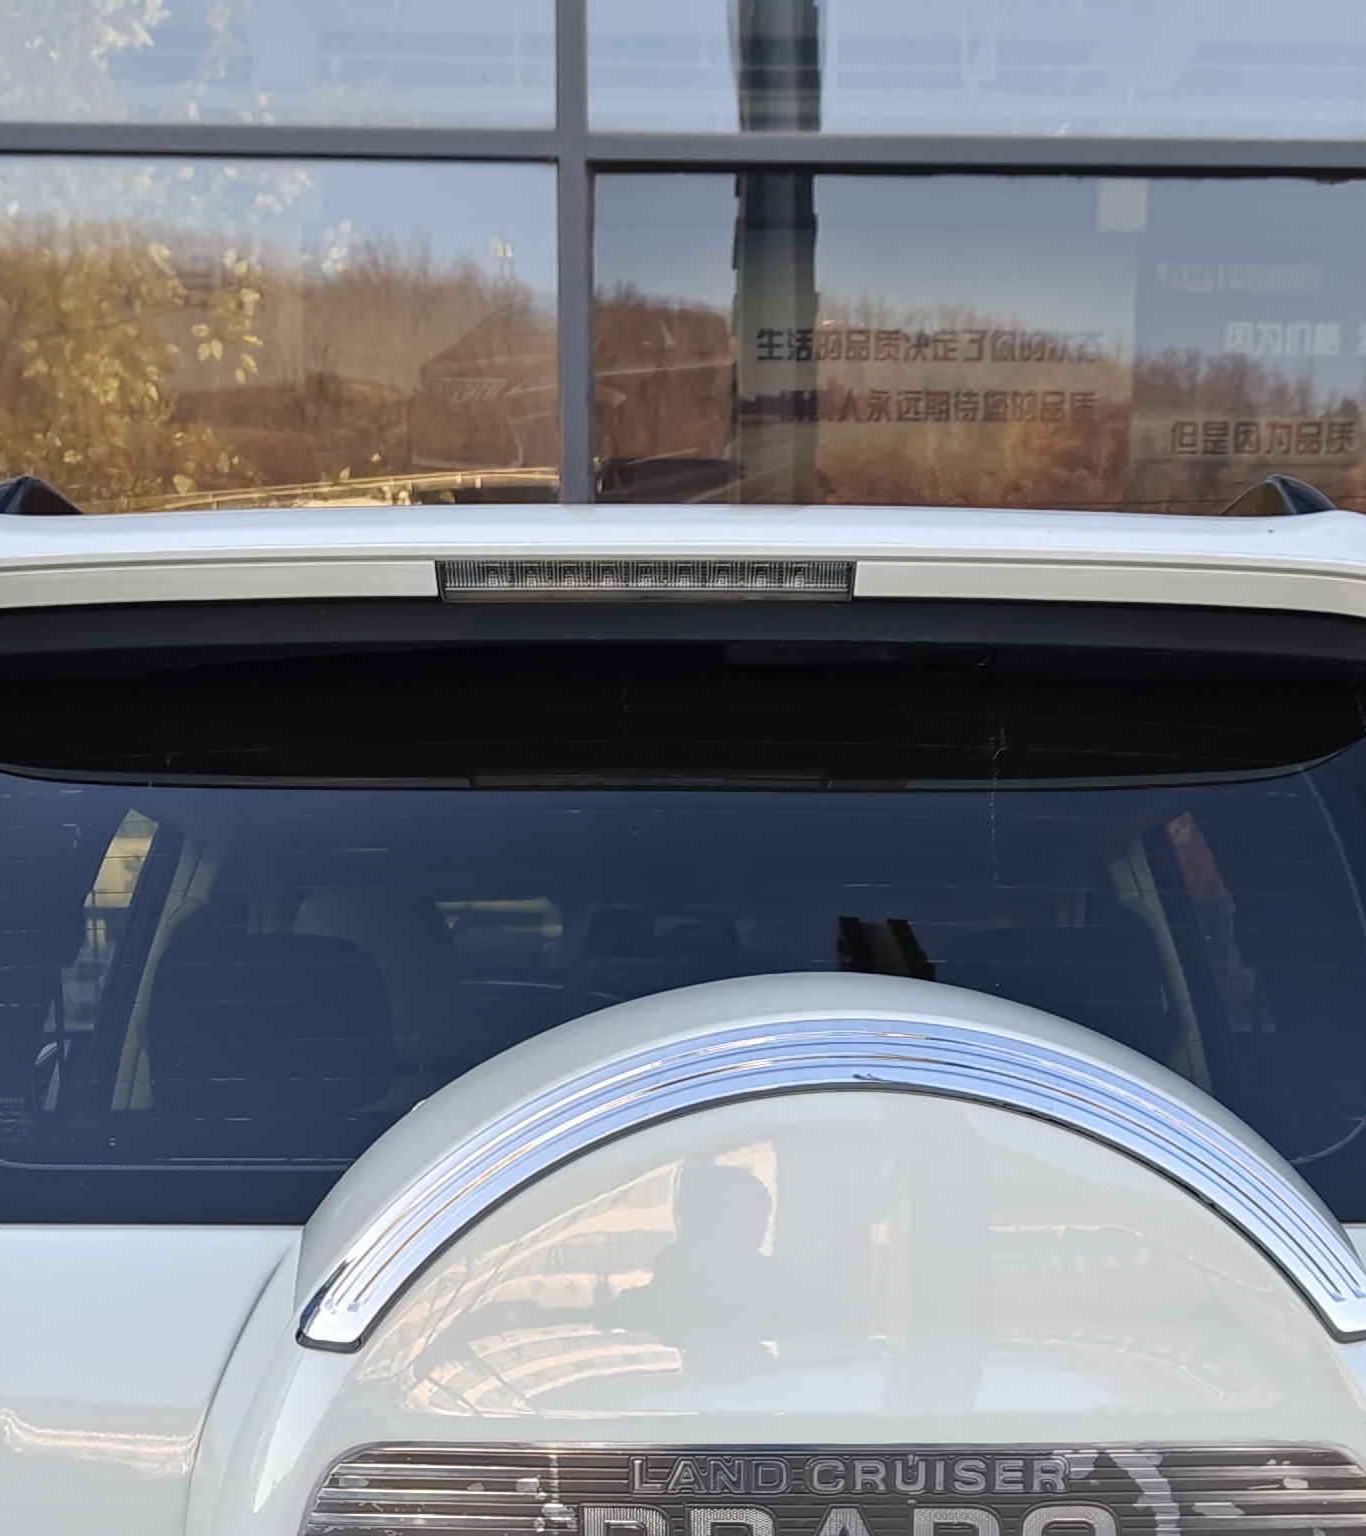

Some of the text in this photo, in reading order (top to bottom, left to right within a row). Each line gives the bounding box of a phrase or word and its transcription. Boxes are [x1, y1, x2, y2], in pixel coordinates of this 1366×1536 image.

[1170, 419, 1357, 456] 但是因为品质
[627, 1454, 1073, 1495] LAND CRUISER
